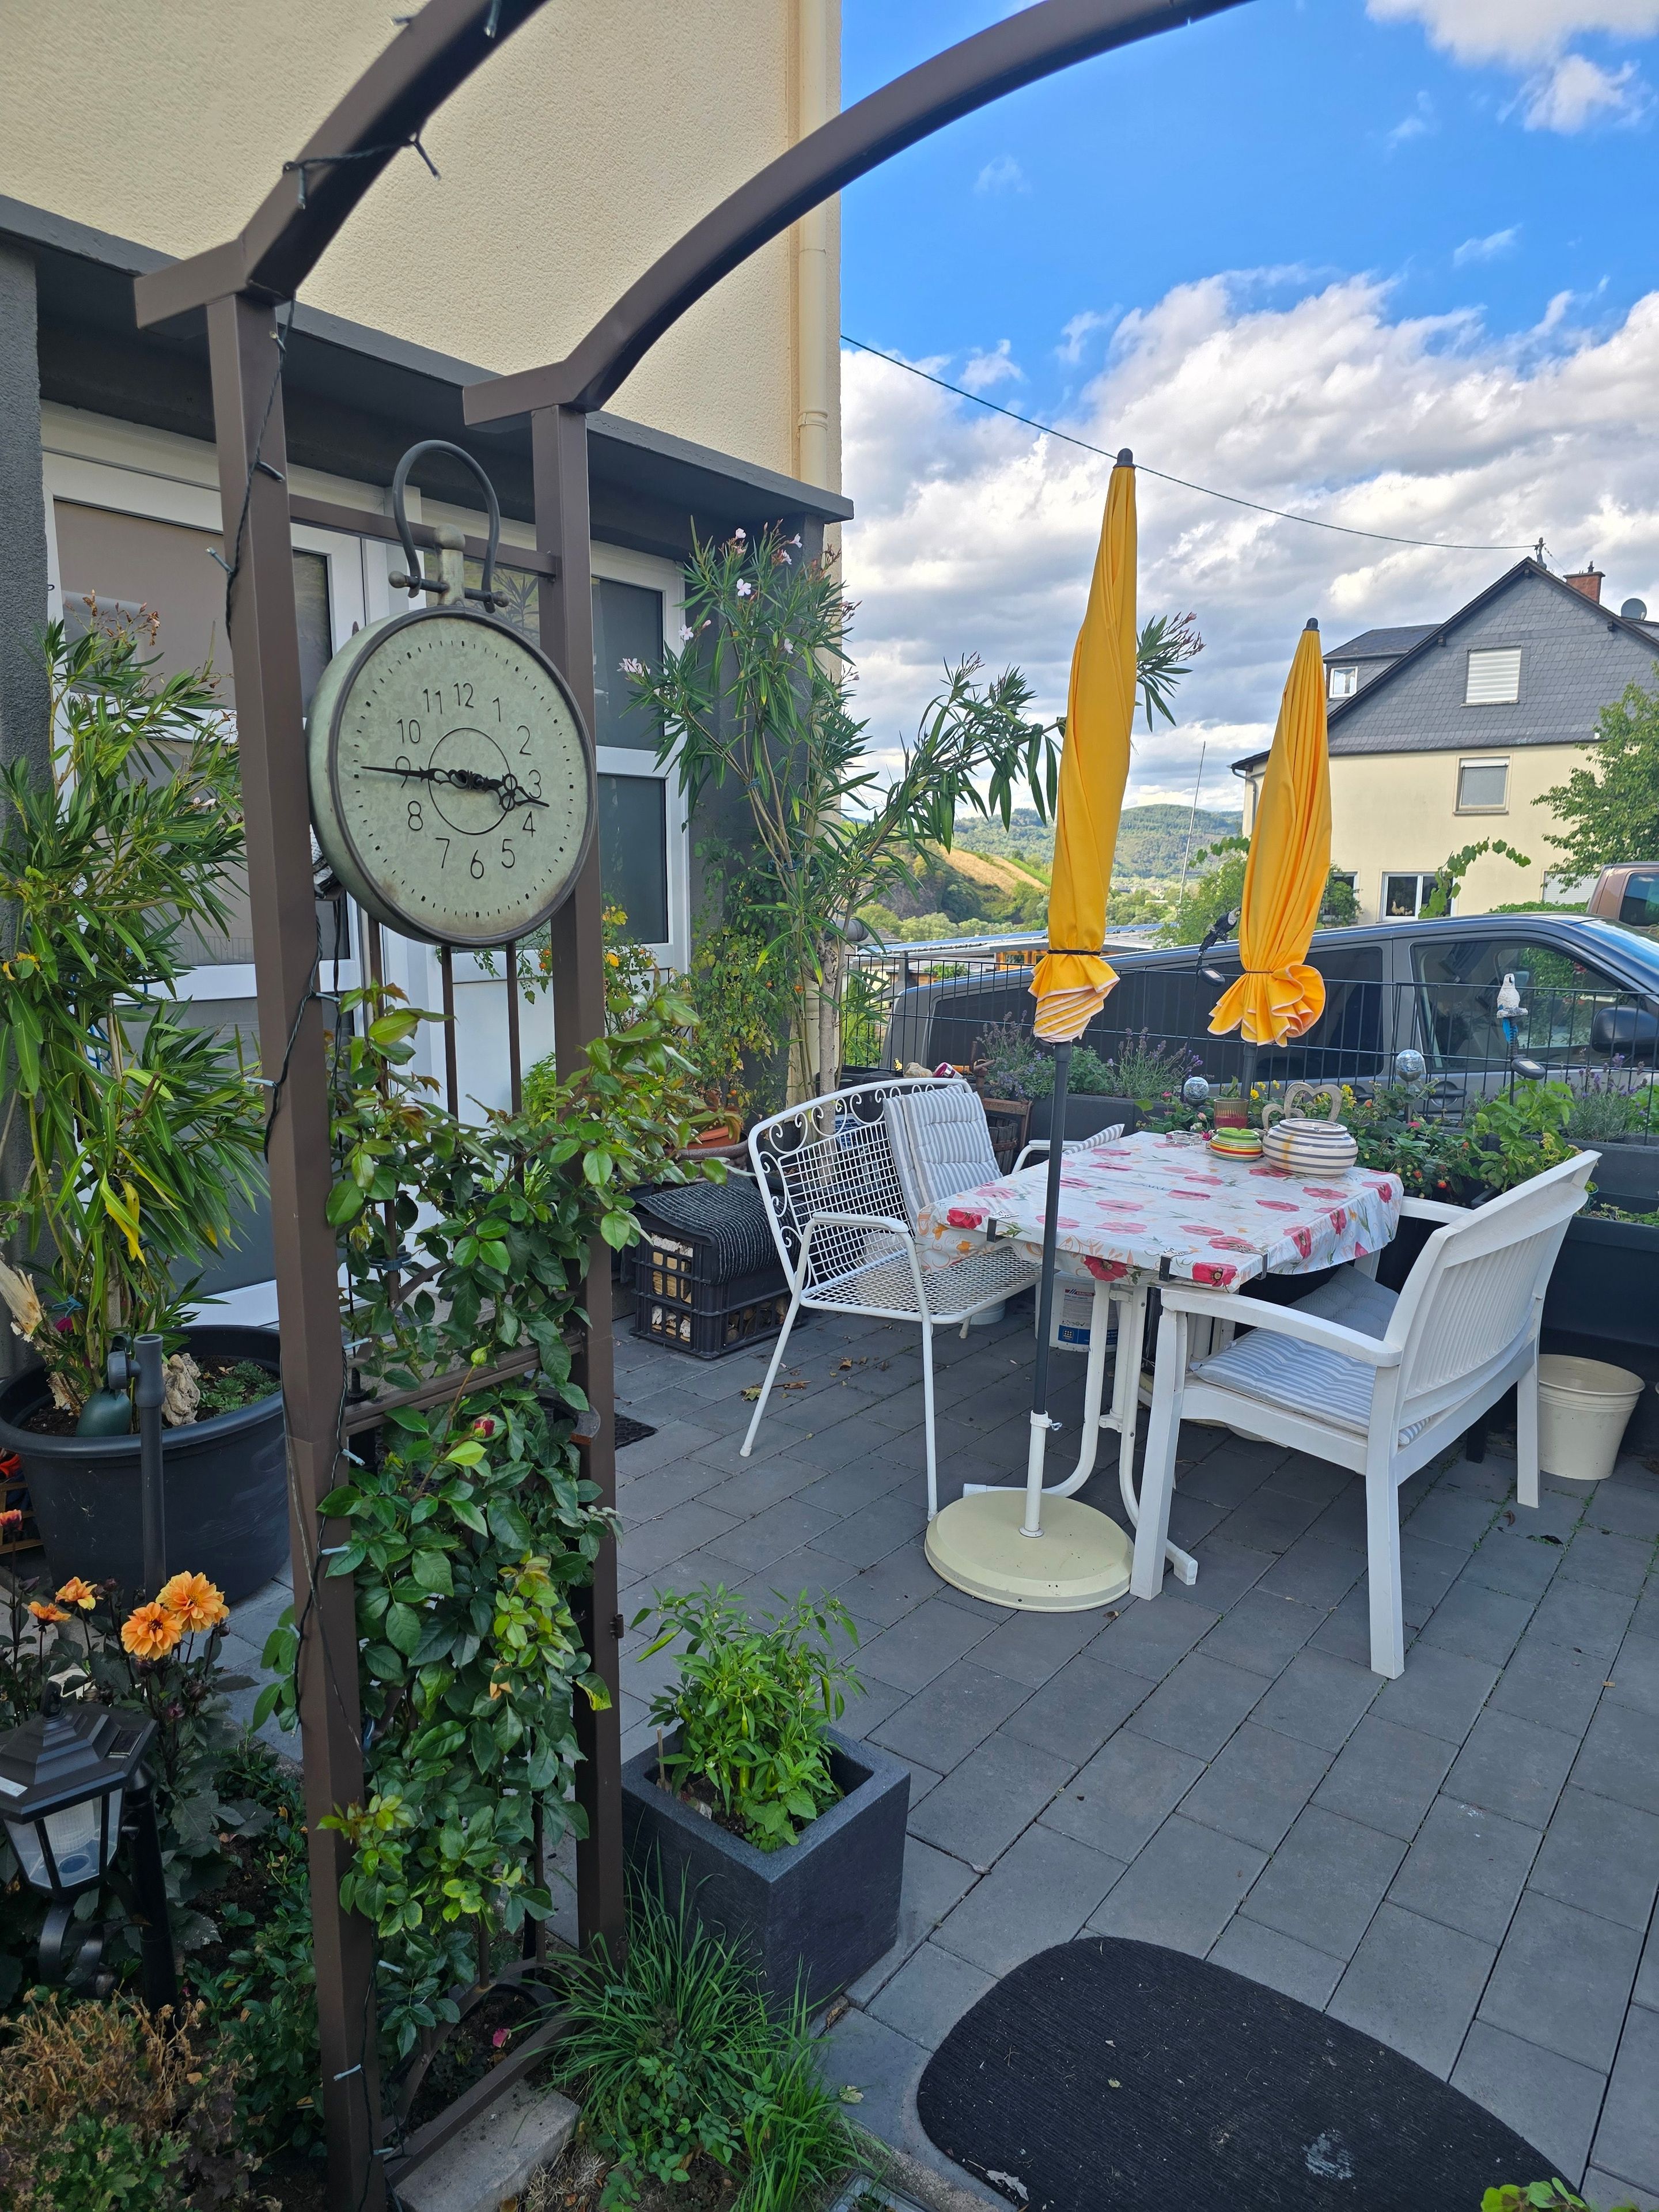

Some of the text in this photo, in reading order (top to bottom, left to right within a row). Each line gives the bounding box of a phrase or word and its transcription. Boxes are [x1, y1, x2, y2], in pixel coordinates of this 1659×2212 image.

[422, 688, 444, 715] 11
[453, 681, 475, 709] 12
[492, 696, 501, 723] 1
[396, 718, 422, 744] 10
[517, 725, 532, 756] 2
[395, 755, 411, 789] 9
[528, 769, 542, 799] 3
[407, 800, 424, 832] 8
[522, 810, 536, 838] 4
[434, 836, 451, 869] 7
[469, 849, 485, 880] 6
[501, 838, 516, 869] 5
